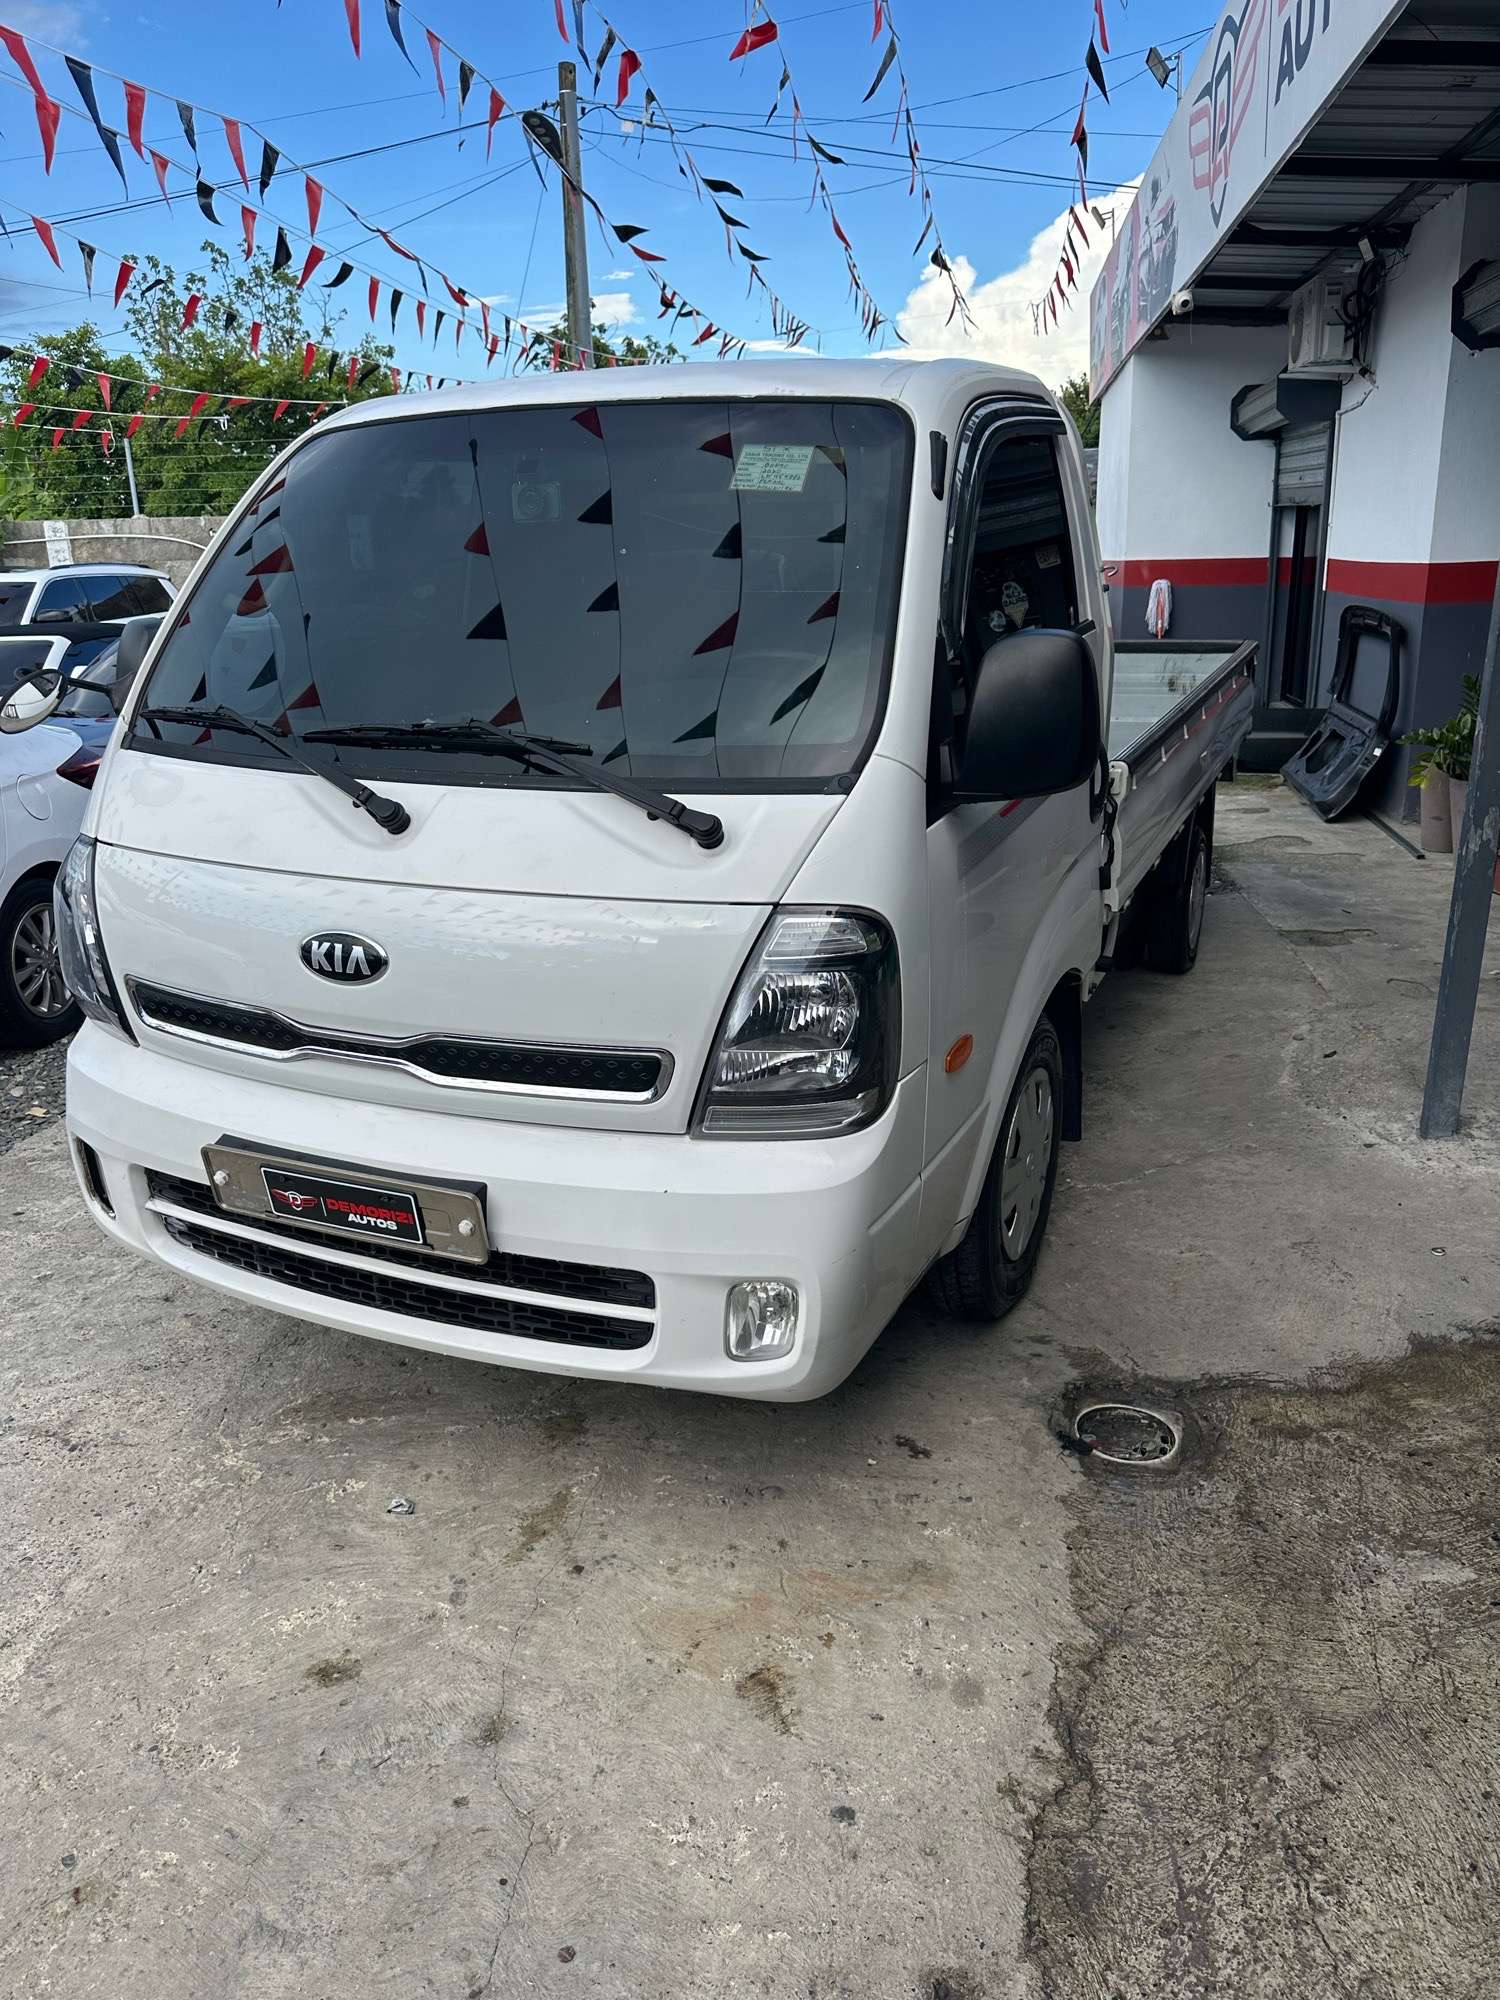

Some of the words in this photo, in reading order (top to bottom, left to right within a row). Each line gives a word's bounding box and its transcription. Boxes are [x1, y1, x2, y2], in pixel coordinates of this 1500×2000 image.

[311, 941, 371, 976] KIA
[326, 1198, 415, 1225] DEMORIZI
[347, 1213, 398, 1231] AUTOS
